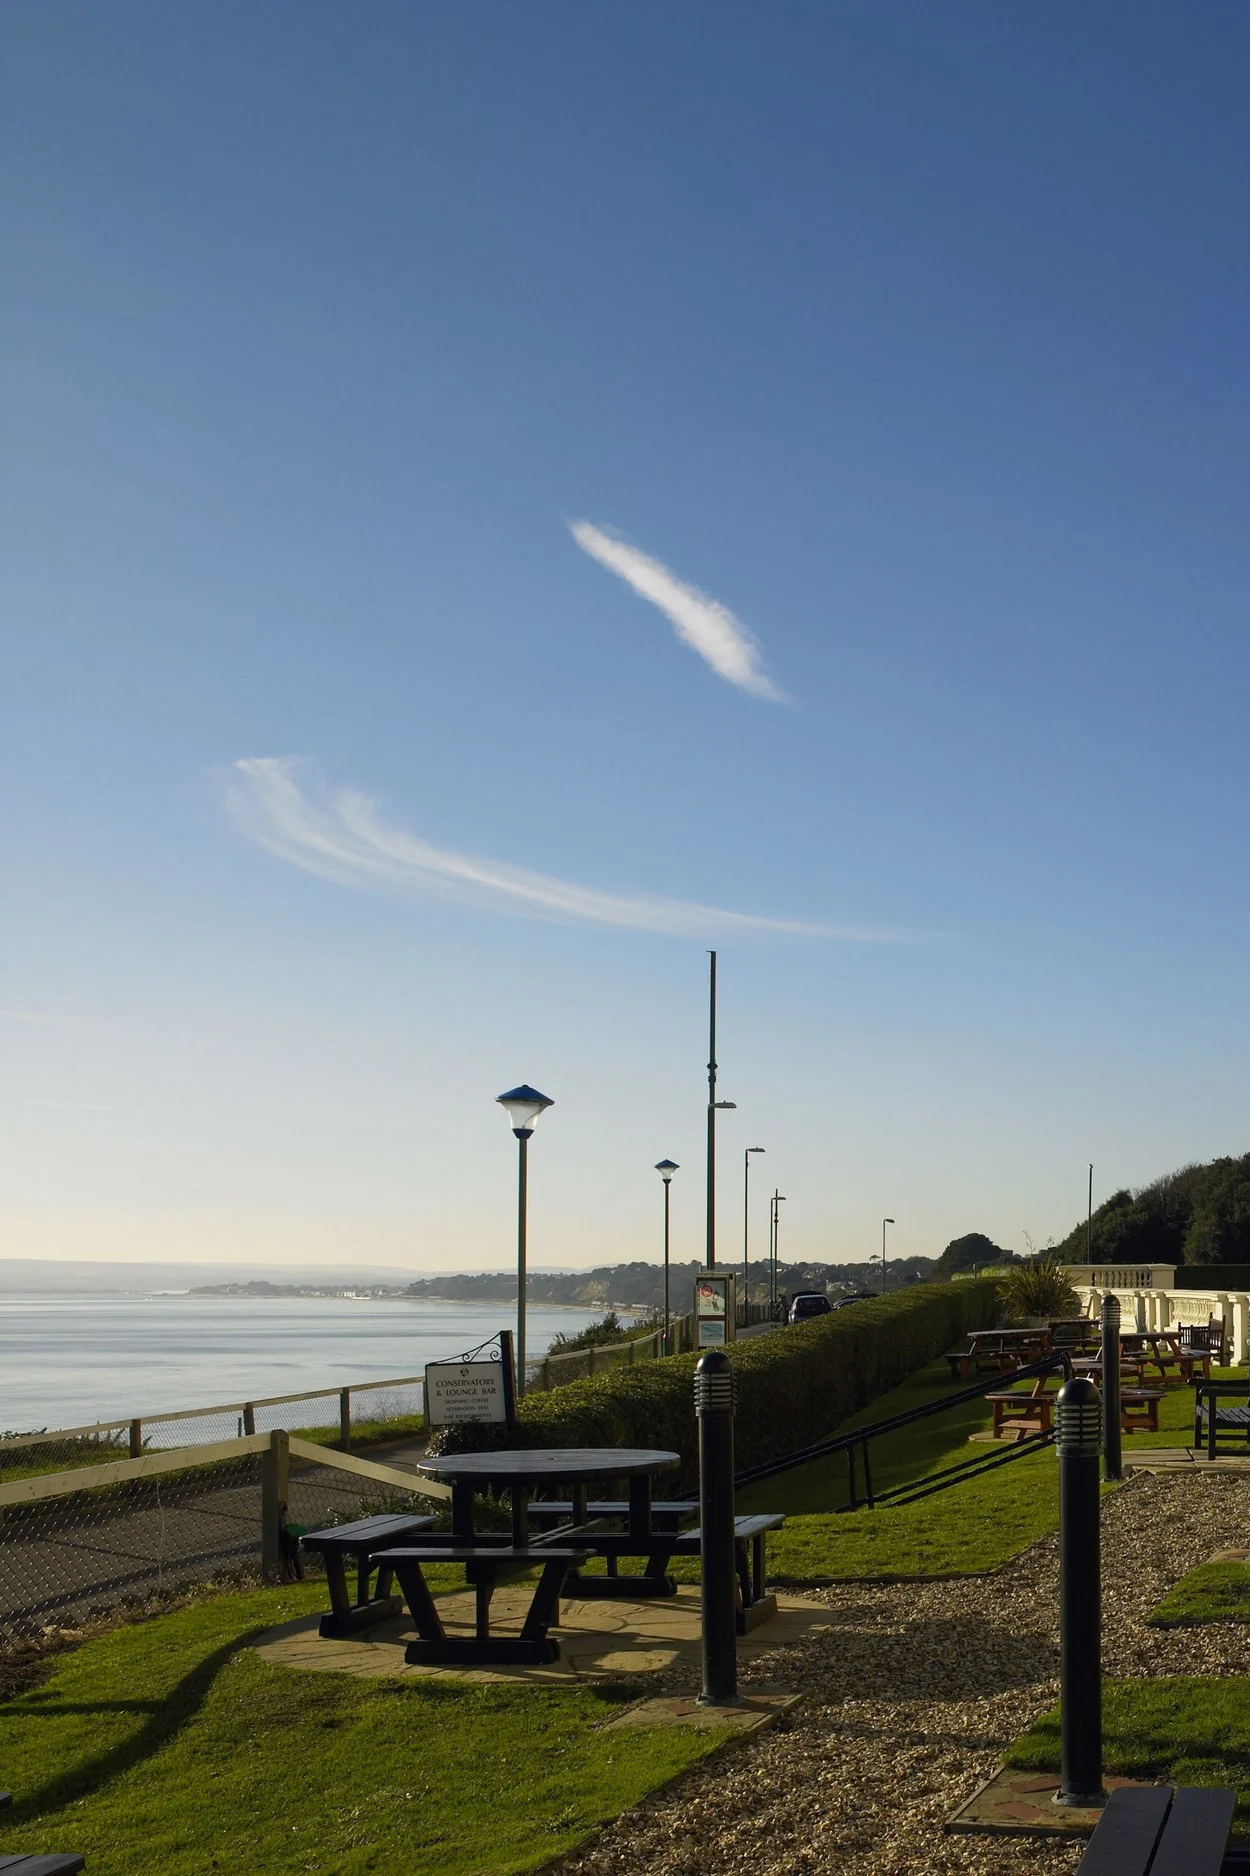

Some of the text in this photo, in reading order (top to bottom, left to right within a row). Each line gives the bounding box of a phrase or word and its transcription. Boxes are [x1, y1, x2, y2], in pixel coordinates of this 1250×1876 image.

[435, 1378, 495, 1388] CONSERVATORY
[446, 1388, 478, 1397] LOUNGE
[481, 1387, 497, 1395] BAR
